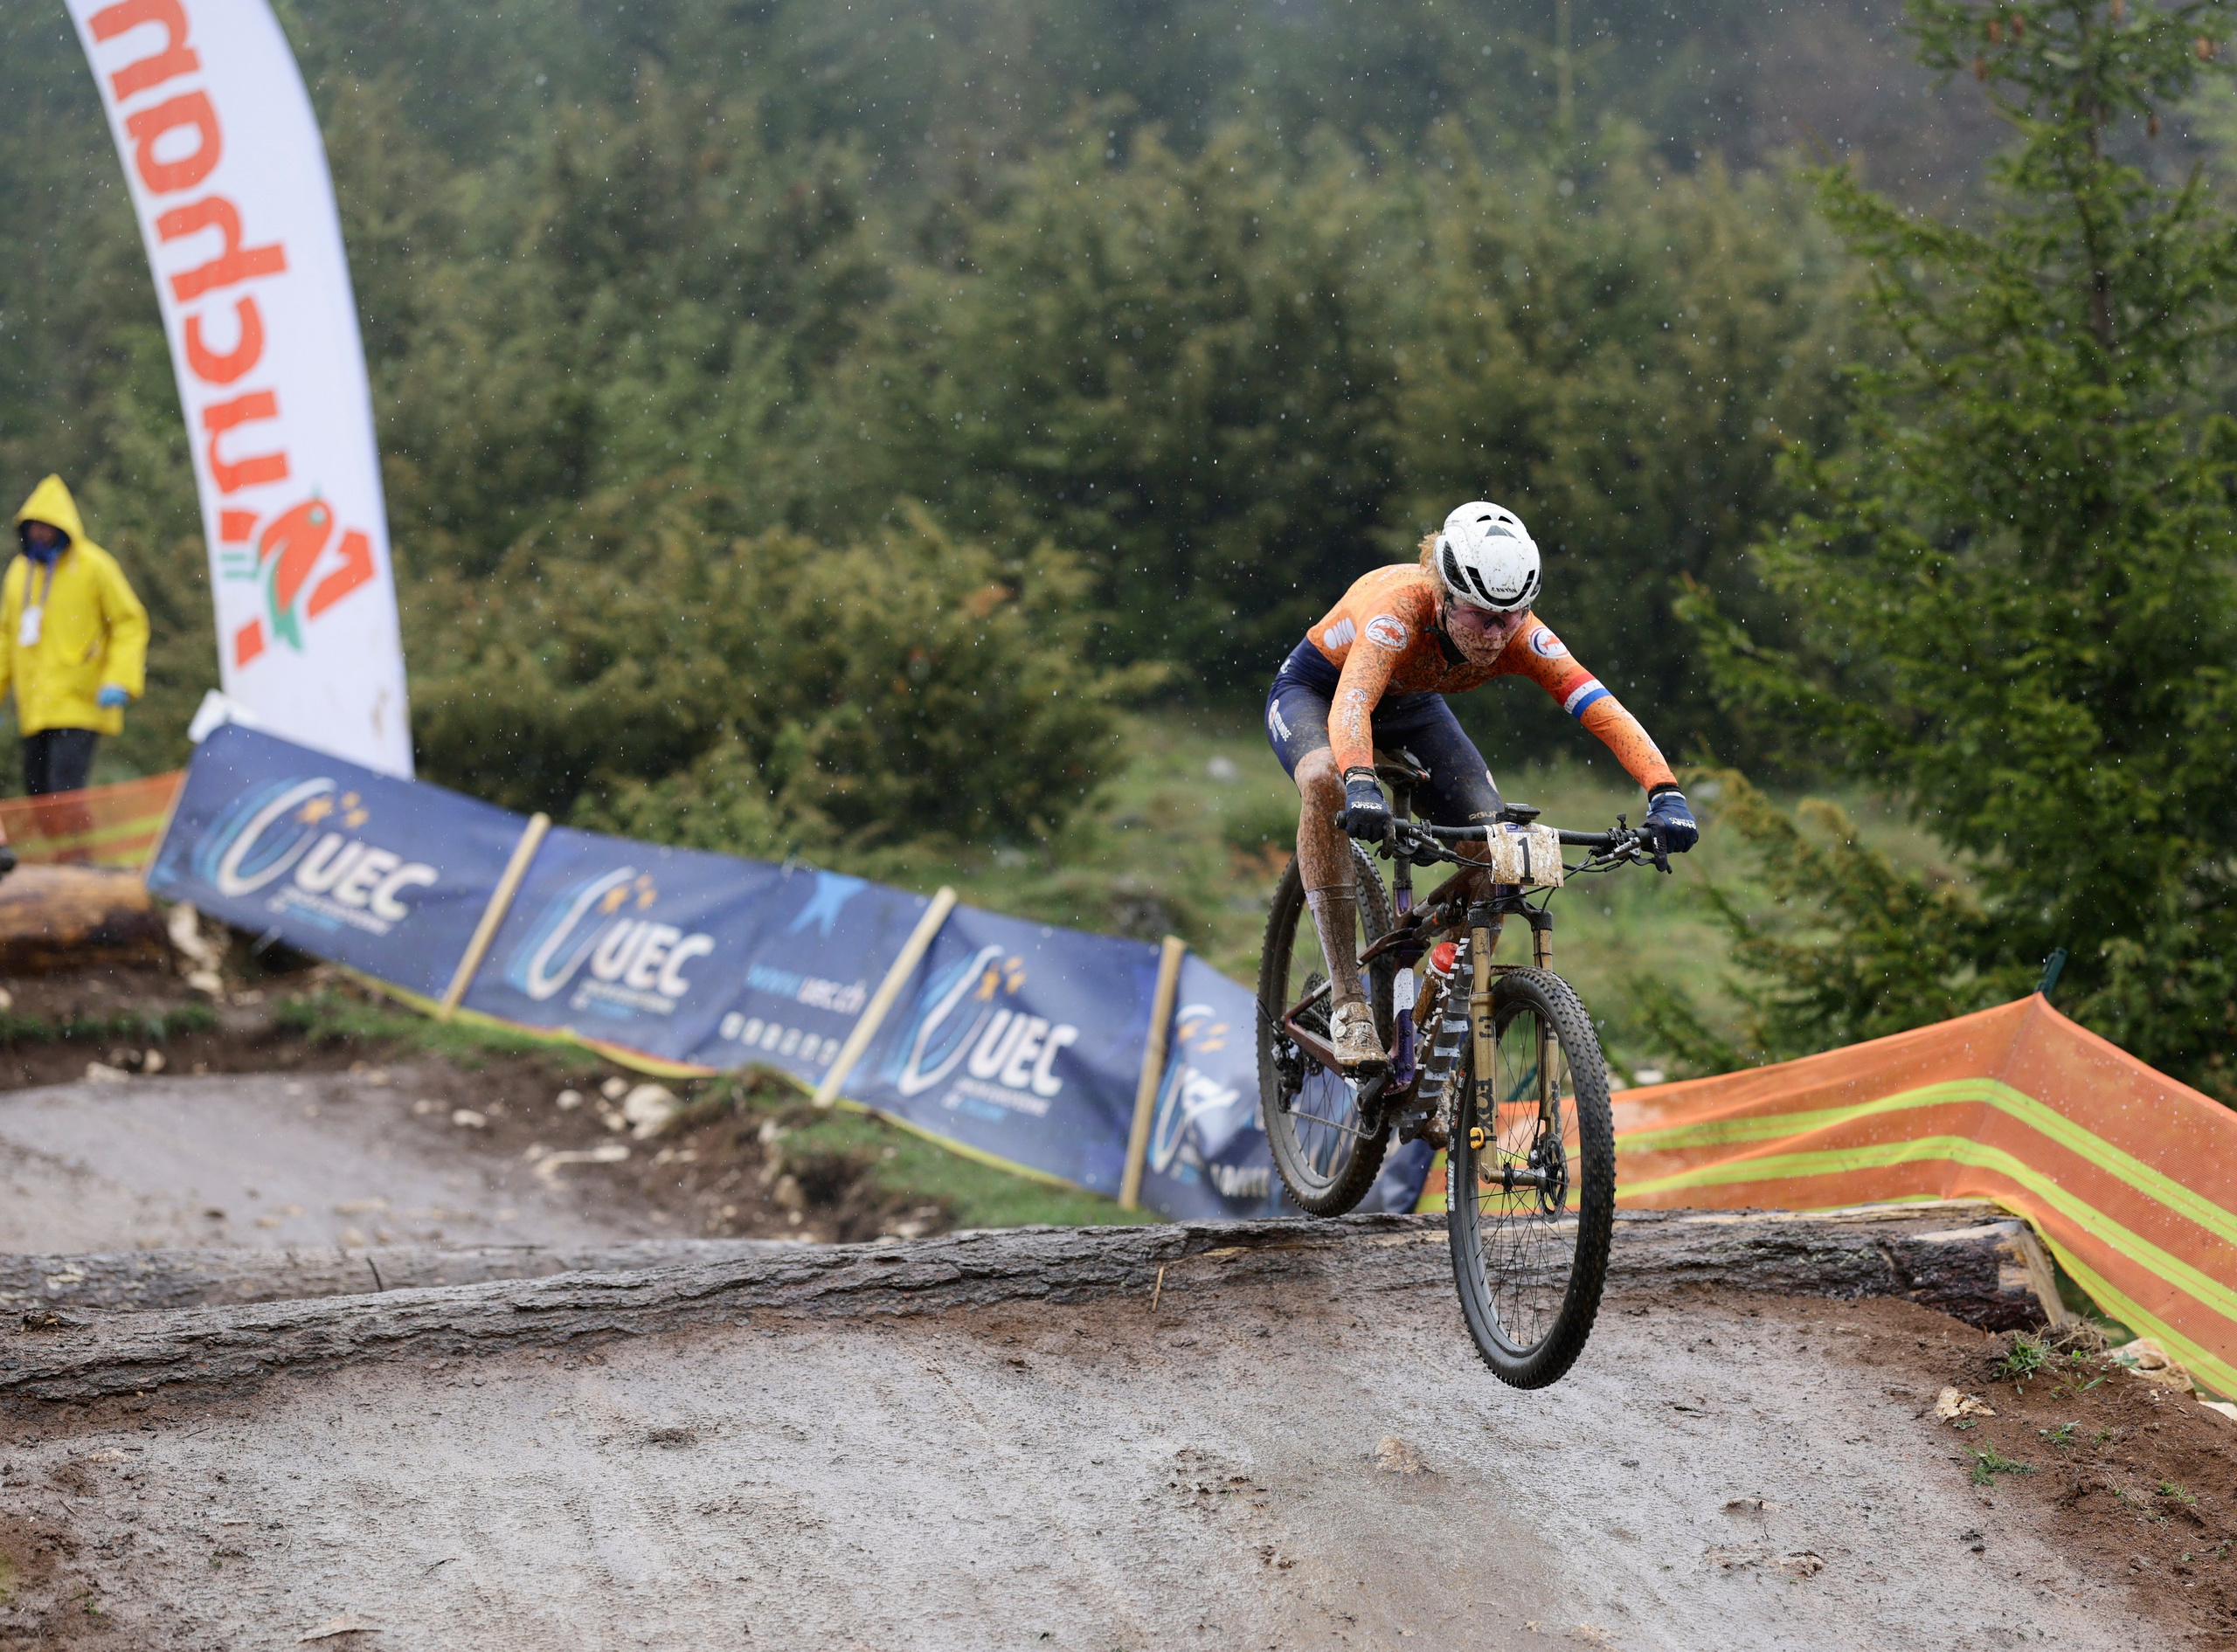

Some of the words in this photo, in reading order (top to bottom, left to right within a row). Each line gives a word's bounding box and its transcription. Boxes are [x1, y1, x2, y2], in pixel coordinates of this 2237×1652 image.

[294, 832, 439, 922] UEC
[1517, 837, 1534, 884] 1
[591, 917, 716, 998] UEC
[967, 1008, 1079, 1097] UEC
[1477, 1077, 1495, 1133] FOX
